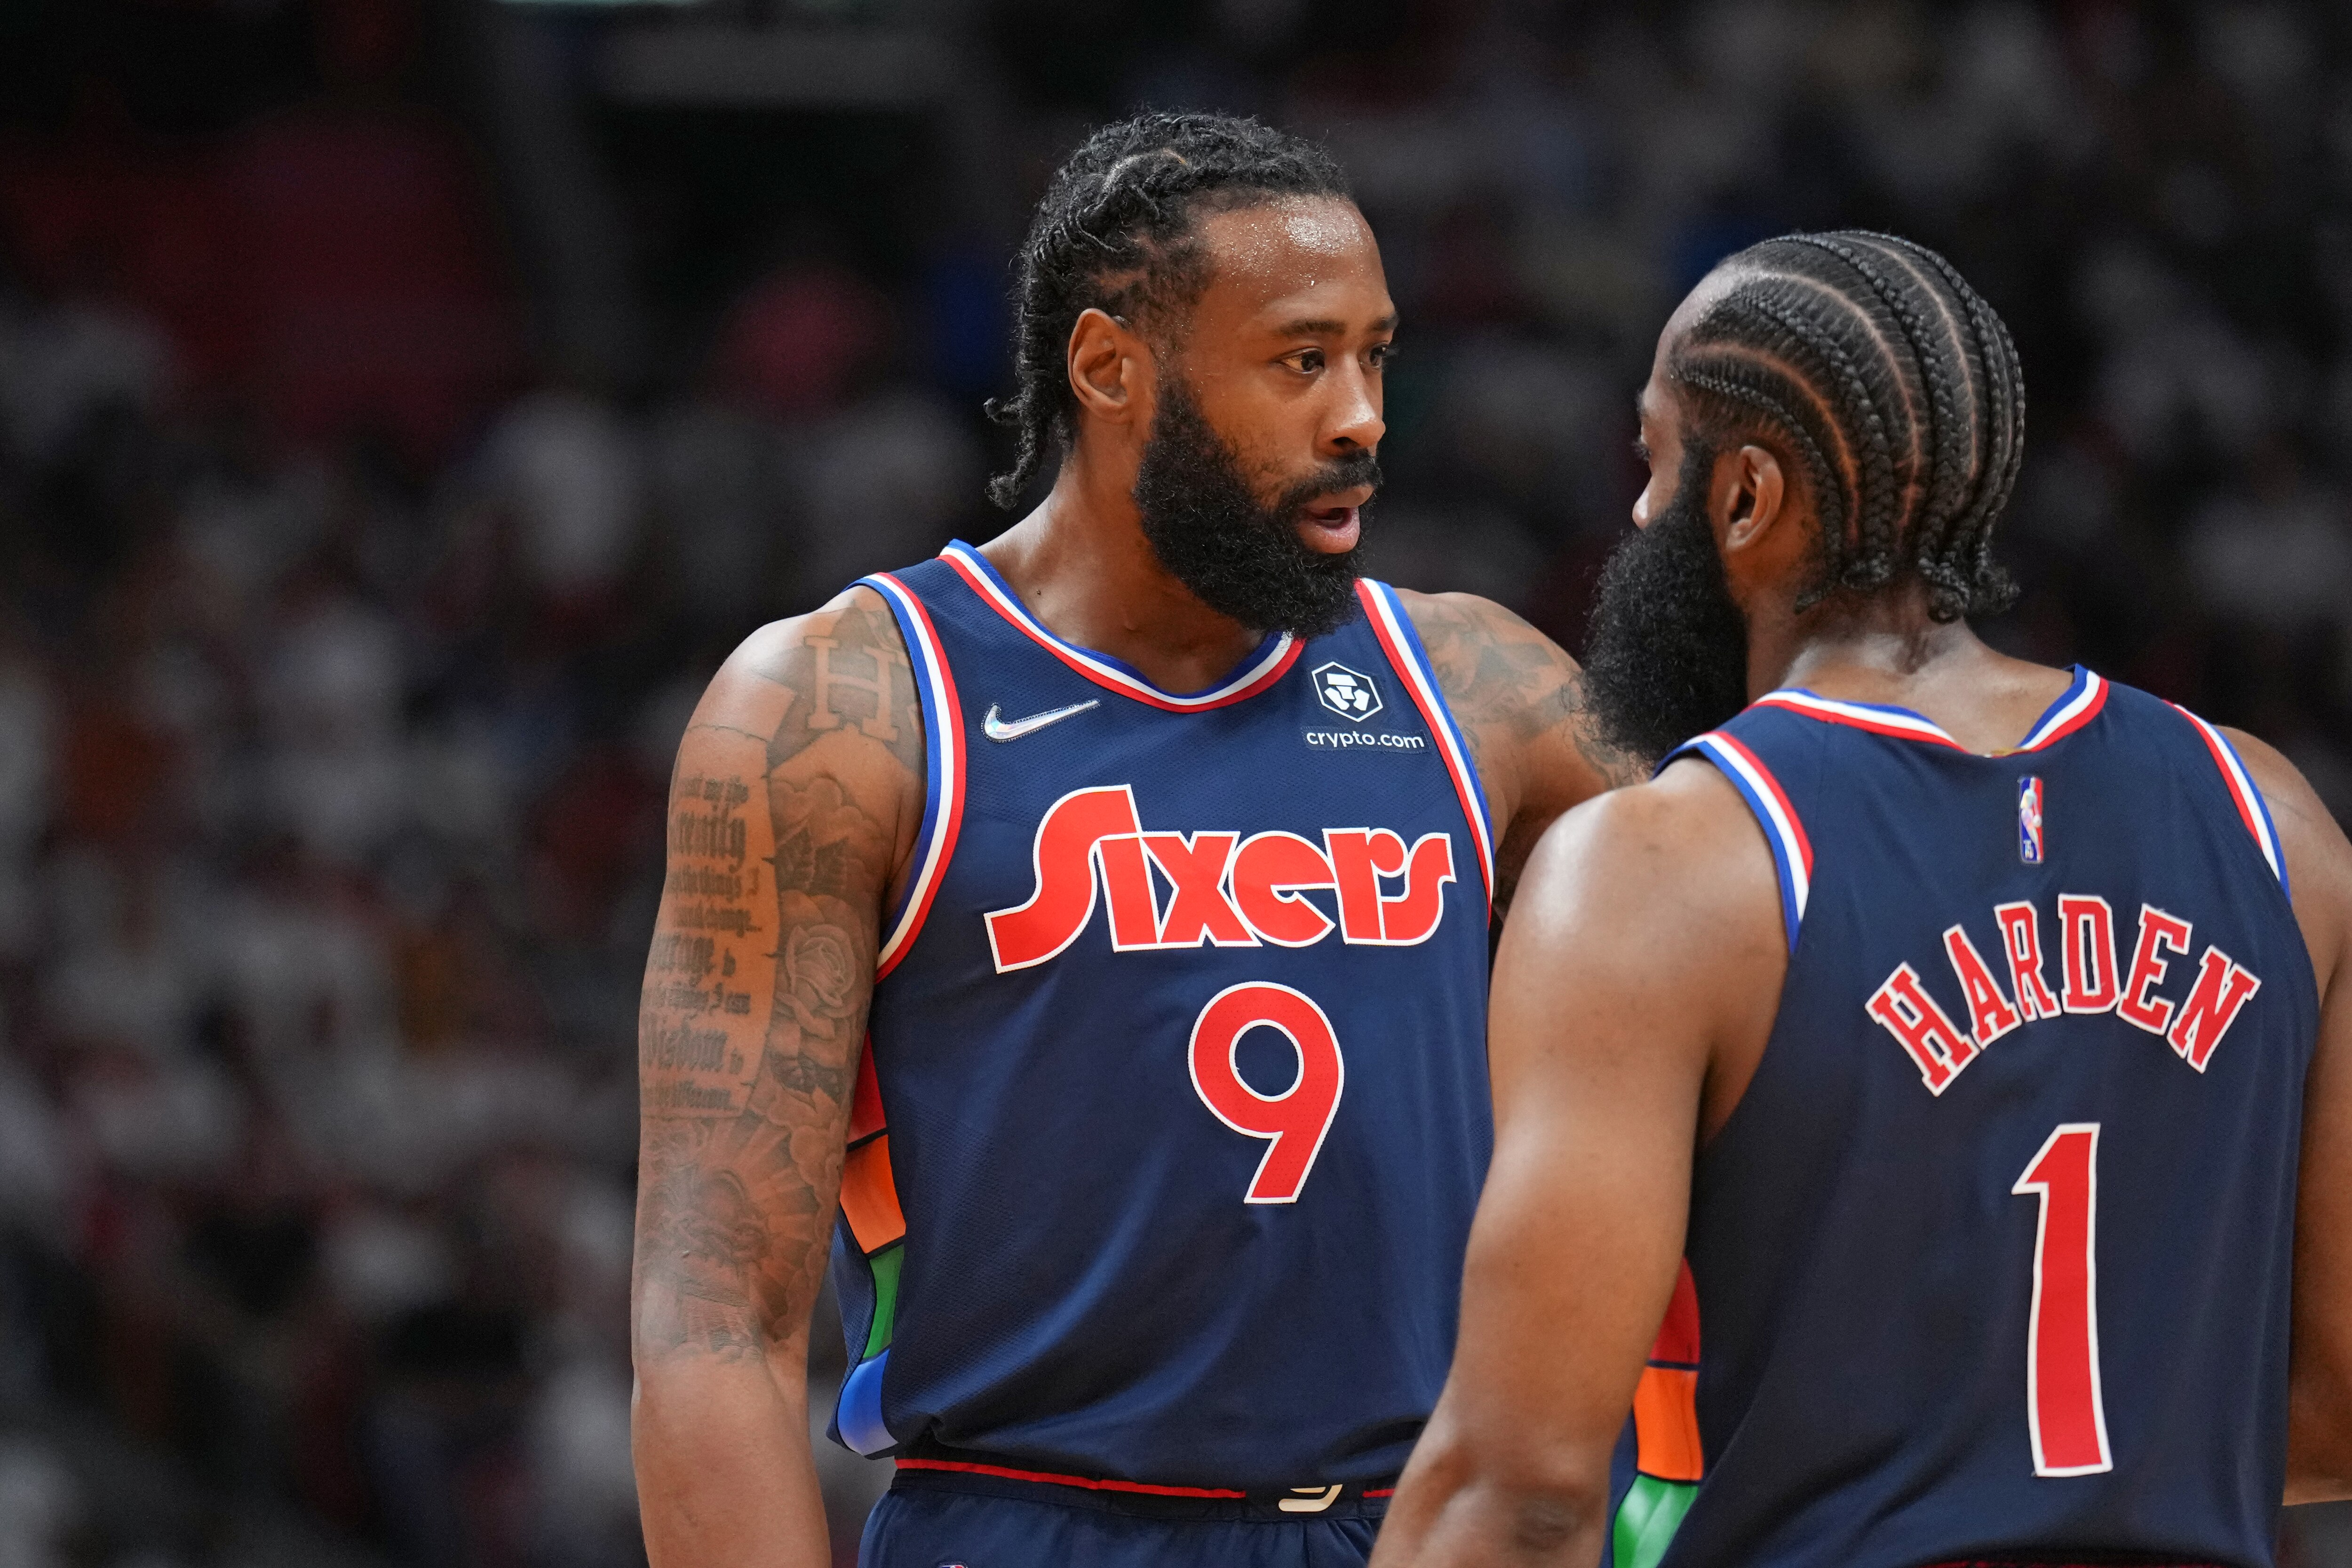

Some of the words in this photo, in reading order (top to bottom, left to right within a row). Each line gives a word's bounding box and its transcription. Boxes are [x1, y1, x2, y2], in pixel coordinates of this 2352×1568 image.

[1306, 730, 1425, 749] crypto.com
[984, 784, 1457, 974] Sixers
[1188, 981, 1345, 1204] 9
[1865, 893, 2262, 1097] HARDEN
[2011, 1122, 2114, 1478] 1
